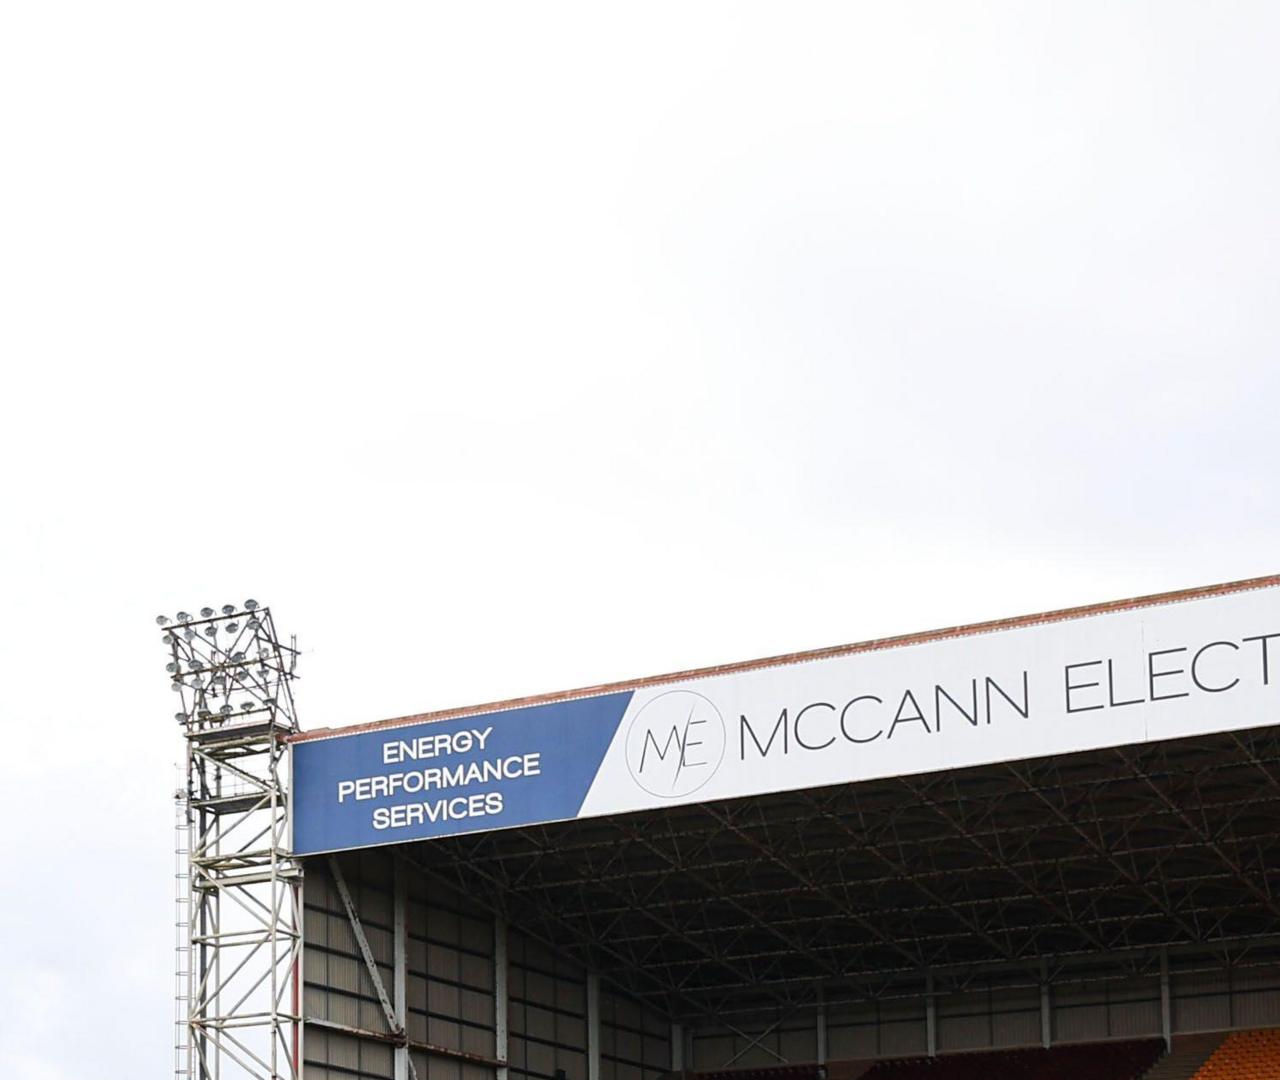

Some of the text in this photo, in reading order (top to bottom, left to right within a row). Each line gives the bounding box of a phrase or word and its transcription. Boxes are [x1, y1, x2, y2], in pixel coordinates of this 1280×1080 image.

[737, 671, 1029, 761] MCCANN
[383, 727, 493, 764] ENERGY
[337, 753, 541, 802] PERFORMANCE
[372, 792, 504, 830] SERVICES
